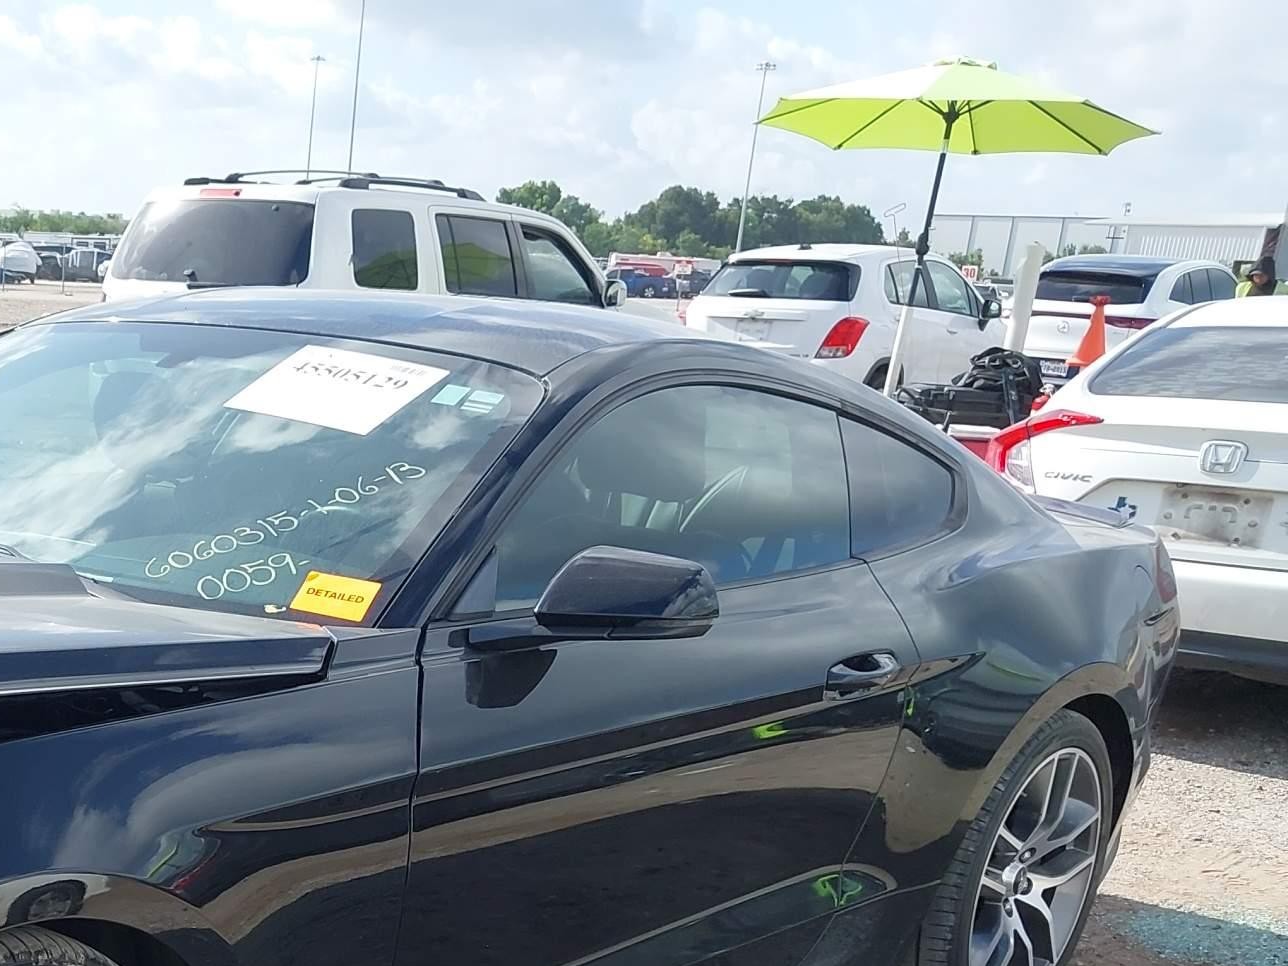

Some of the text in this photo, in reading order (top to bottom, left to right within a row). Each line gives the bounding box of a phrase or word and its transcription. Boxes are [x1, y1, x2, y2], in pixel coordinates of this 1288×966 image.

[963, 267, 976, 279] 30
[1044, 471, 1094, 483] CIVIC
[305, 586, 365, 604] DETAILED
